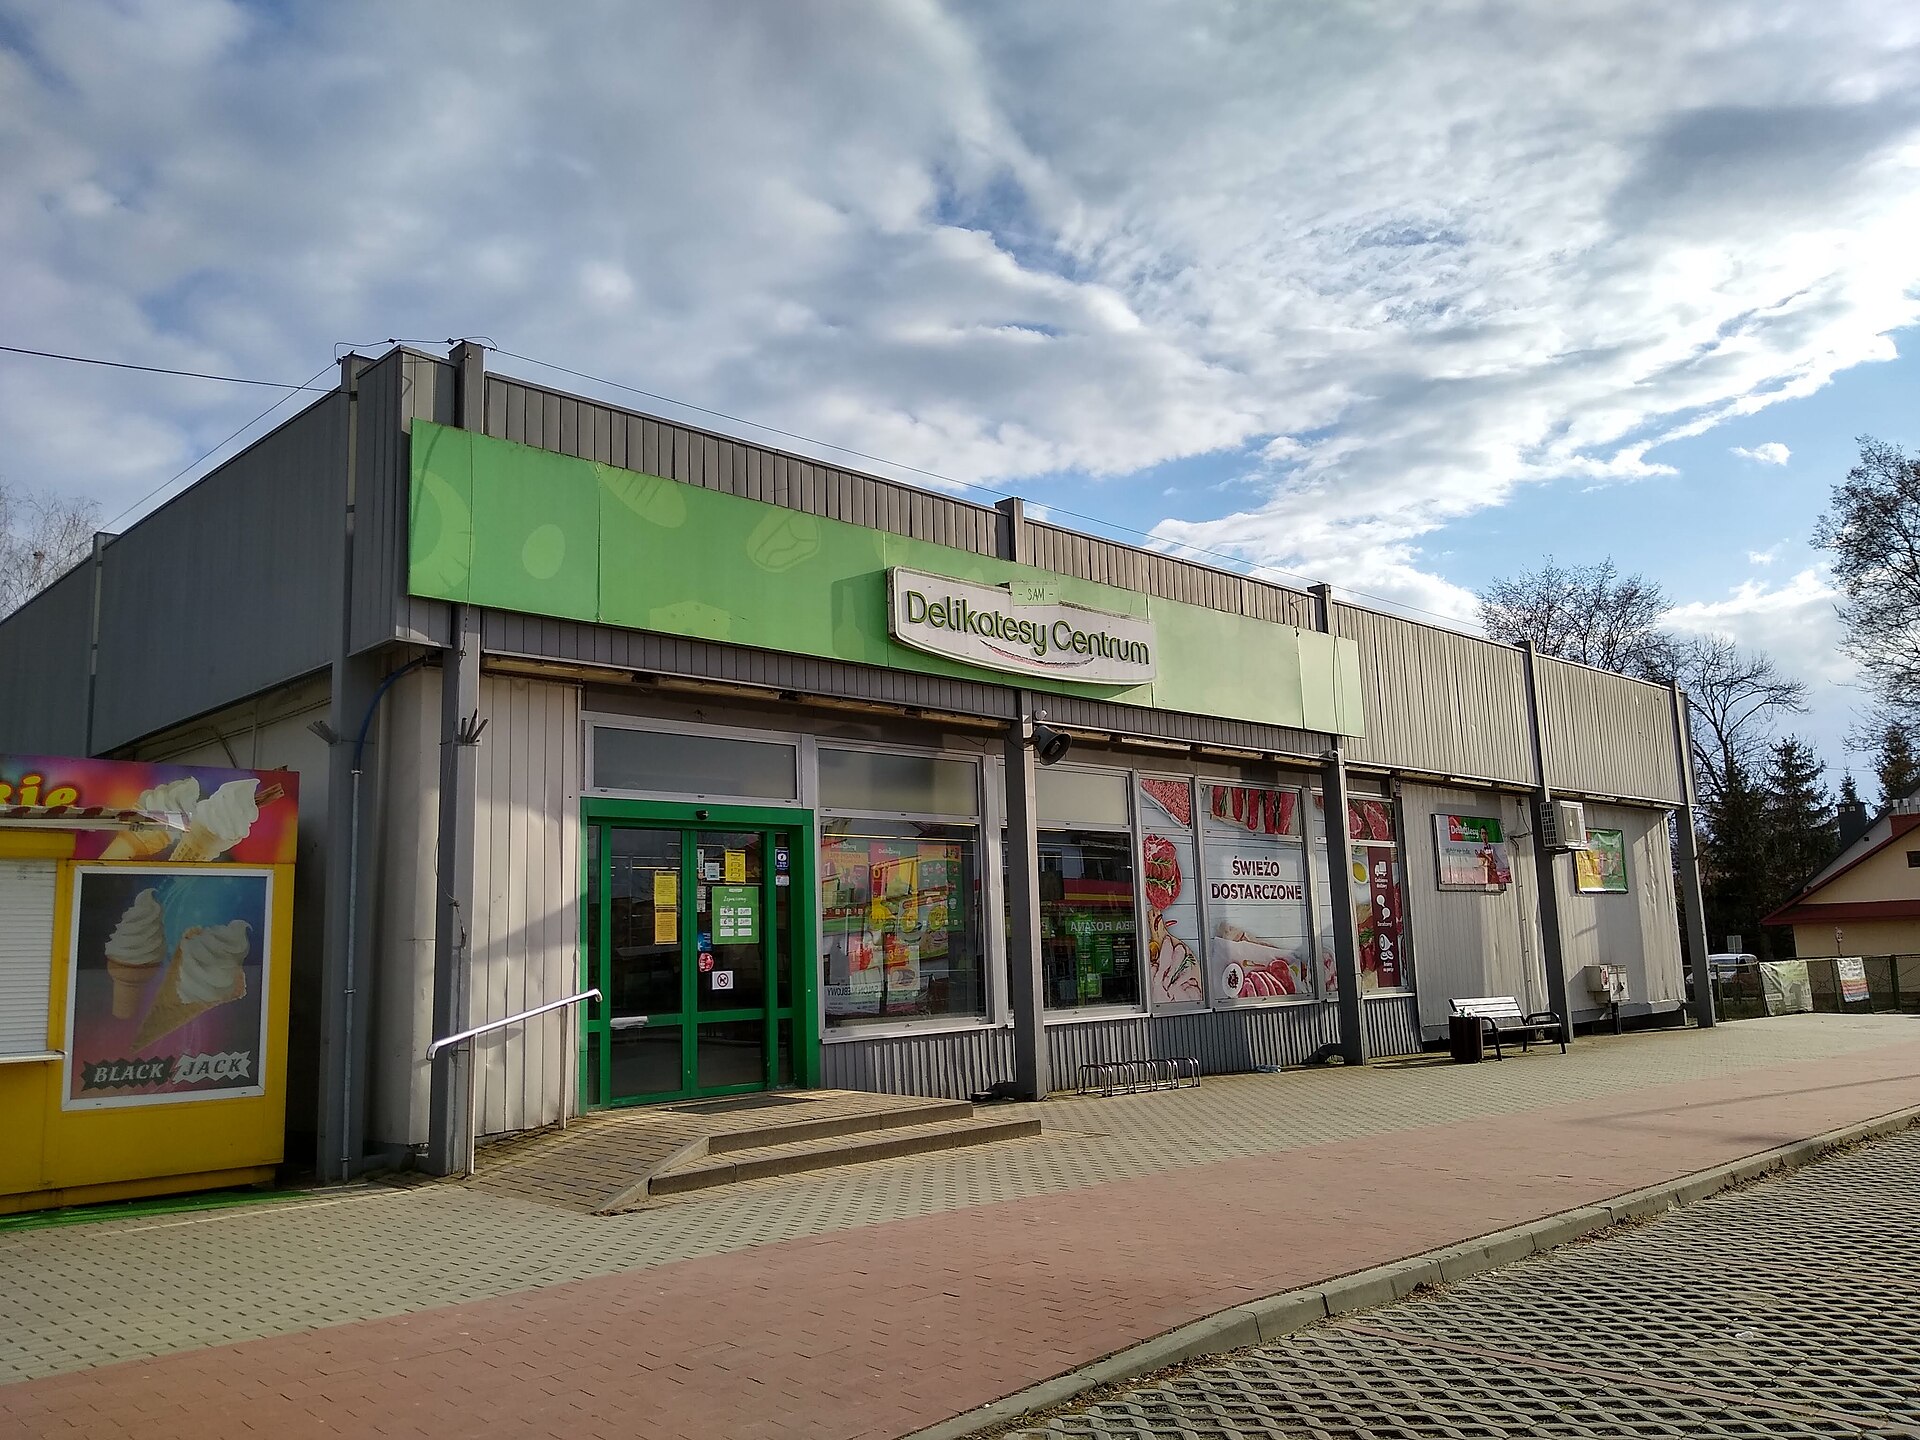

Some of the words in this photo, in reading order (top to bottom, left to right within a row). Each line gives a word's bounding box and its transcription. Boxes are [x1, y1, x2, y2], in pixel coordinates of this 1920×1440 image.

[907, 590, 1046, 656] Delikatesy
[1053, 620, 1149, 665] Centrum
[1232, 855, 1280, 877] ŚWIEŻO
[1211, 883, 1303, 900] DOSTARCZONE
[93, 1062, 164, 1083] BLACK
[181, 1057, 242, 1077] JACK
